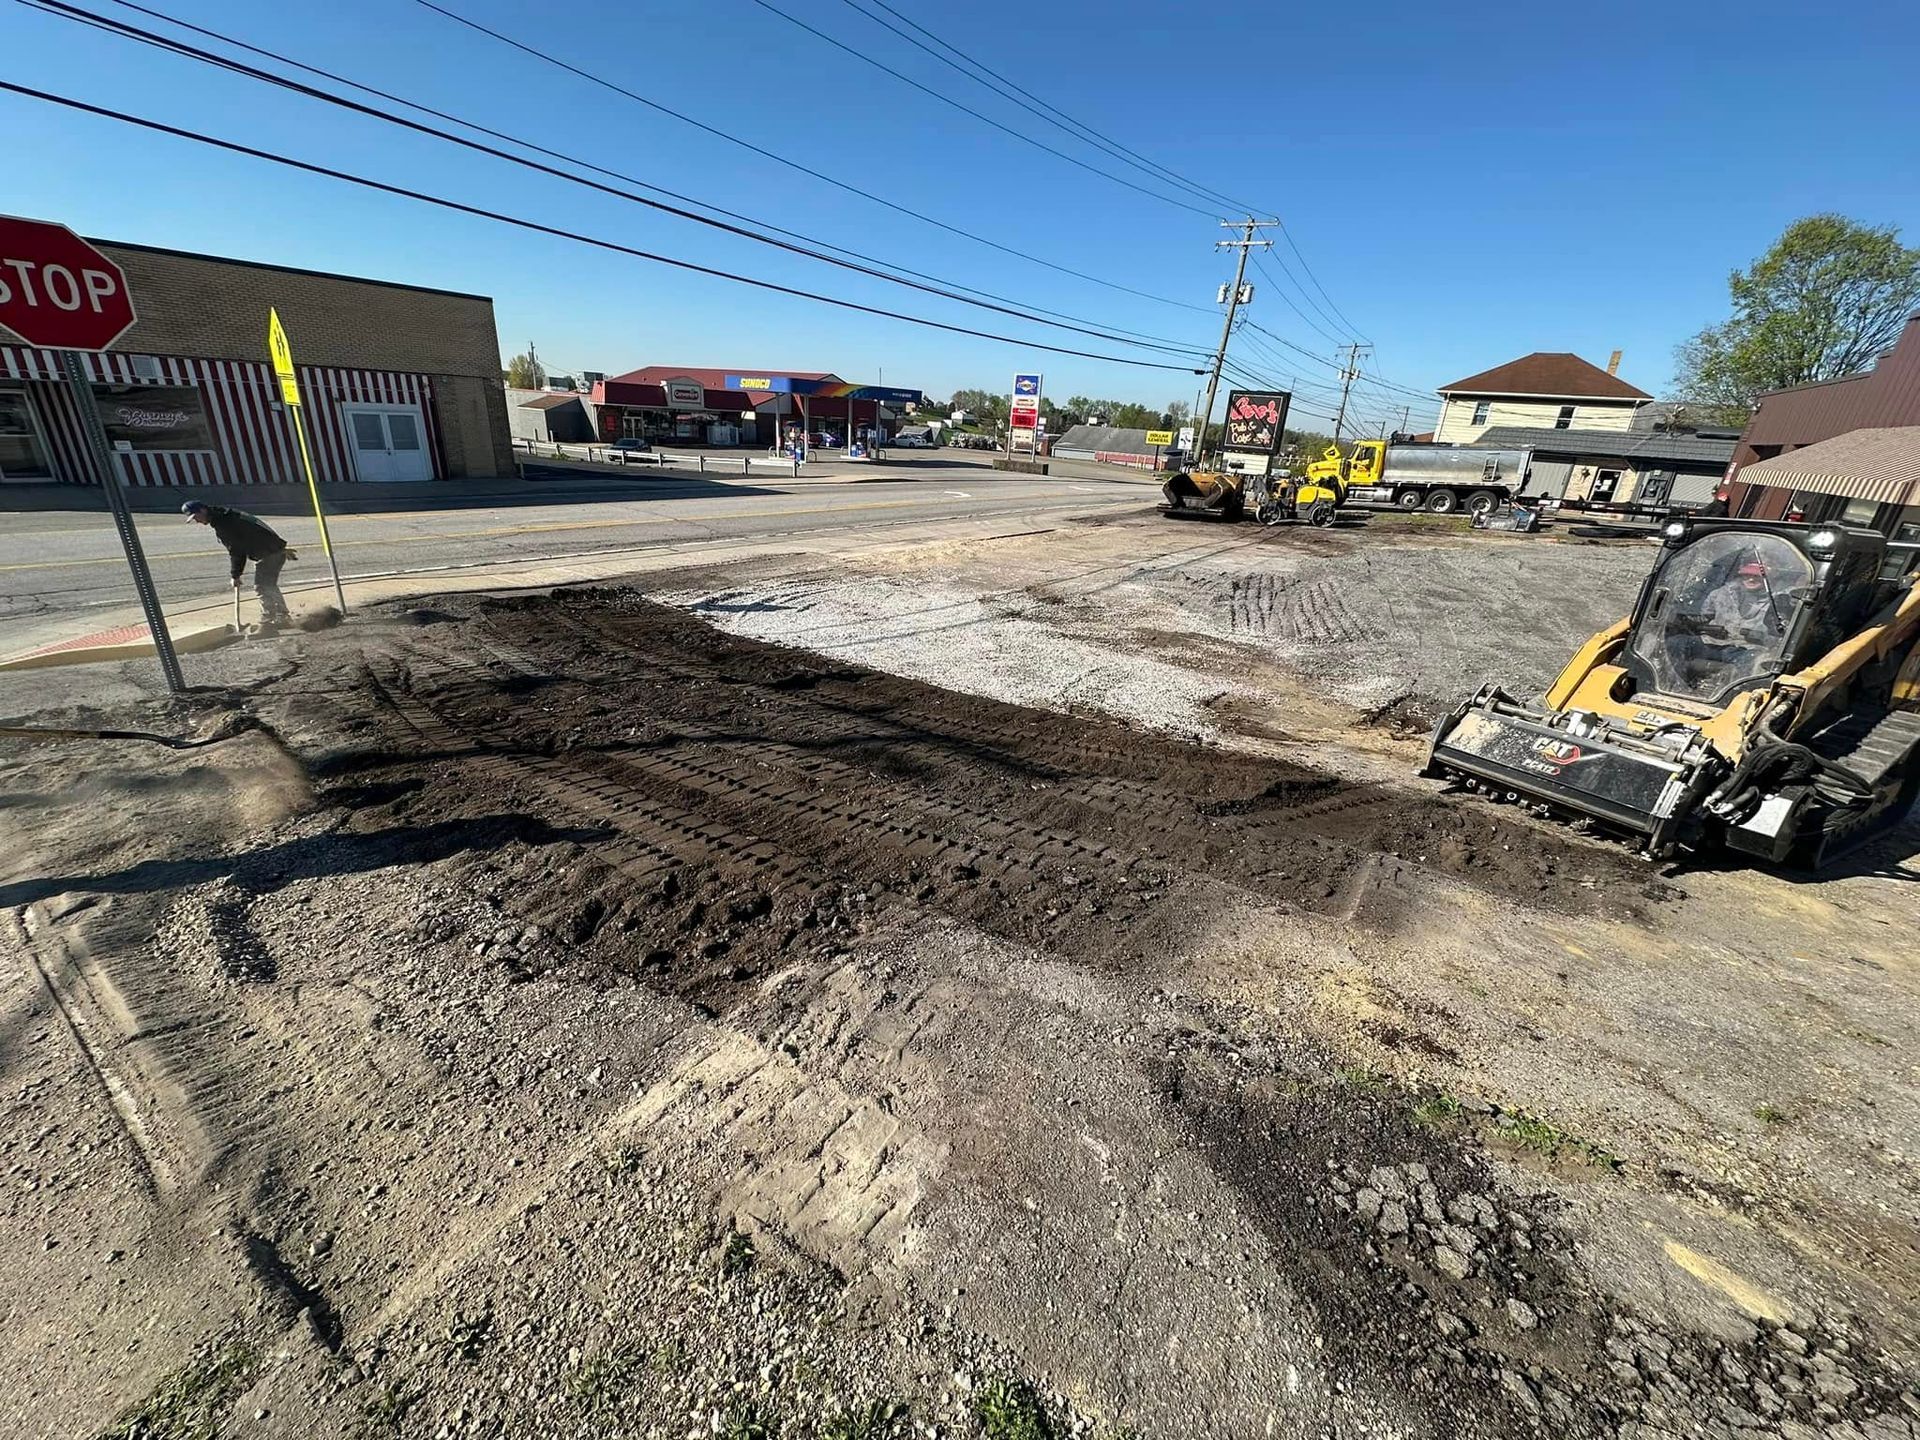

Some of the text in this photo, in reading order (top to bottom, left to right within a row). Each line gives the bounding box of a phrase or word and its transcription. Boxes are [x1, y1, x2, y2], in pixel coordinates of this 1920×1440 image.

[739, 378, 771, 389] SUNOCO
[1230, 421, 1247, 433] Pub
[1532, 737, 1573, 758] CAT
